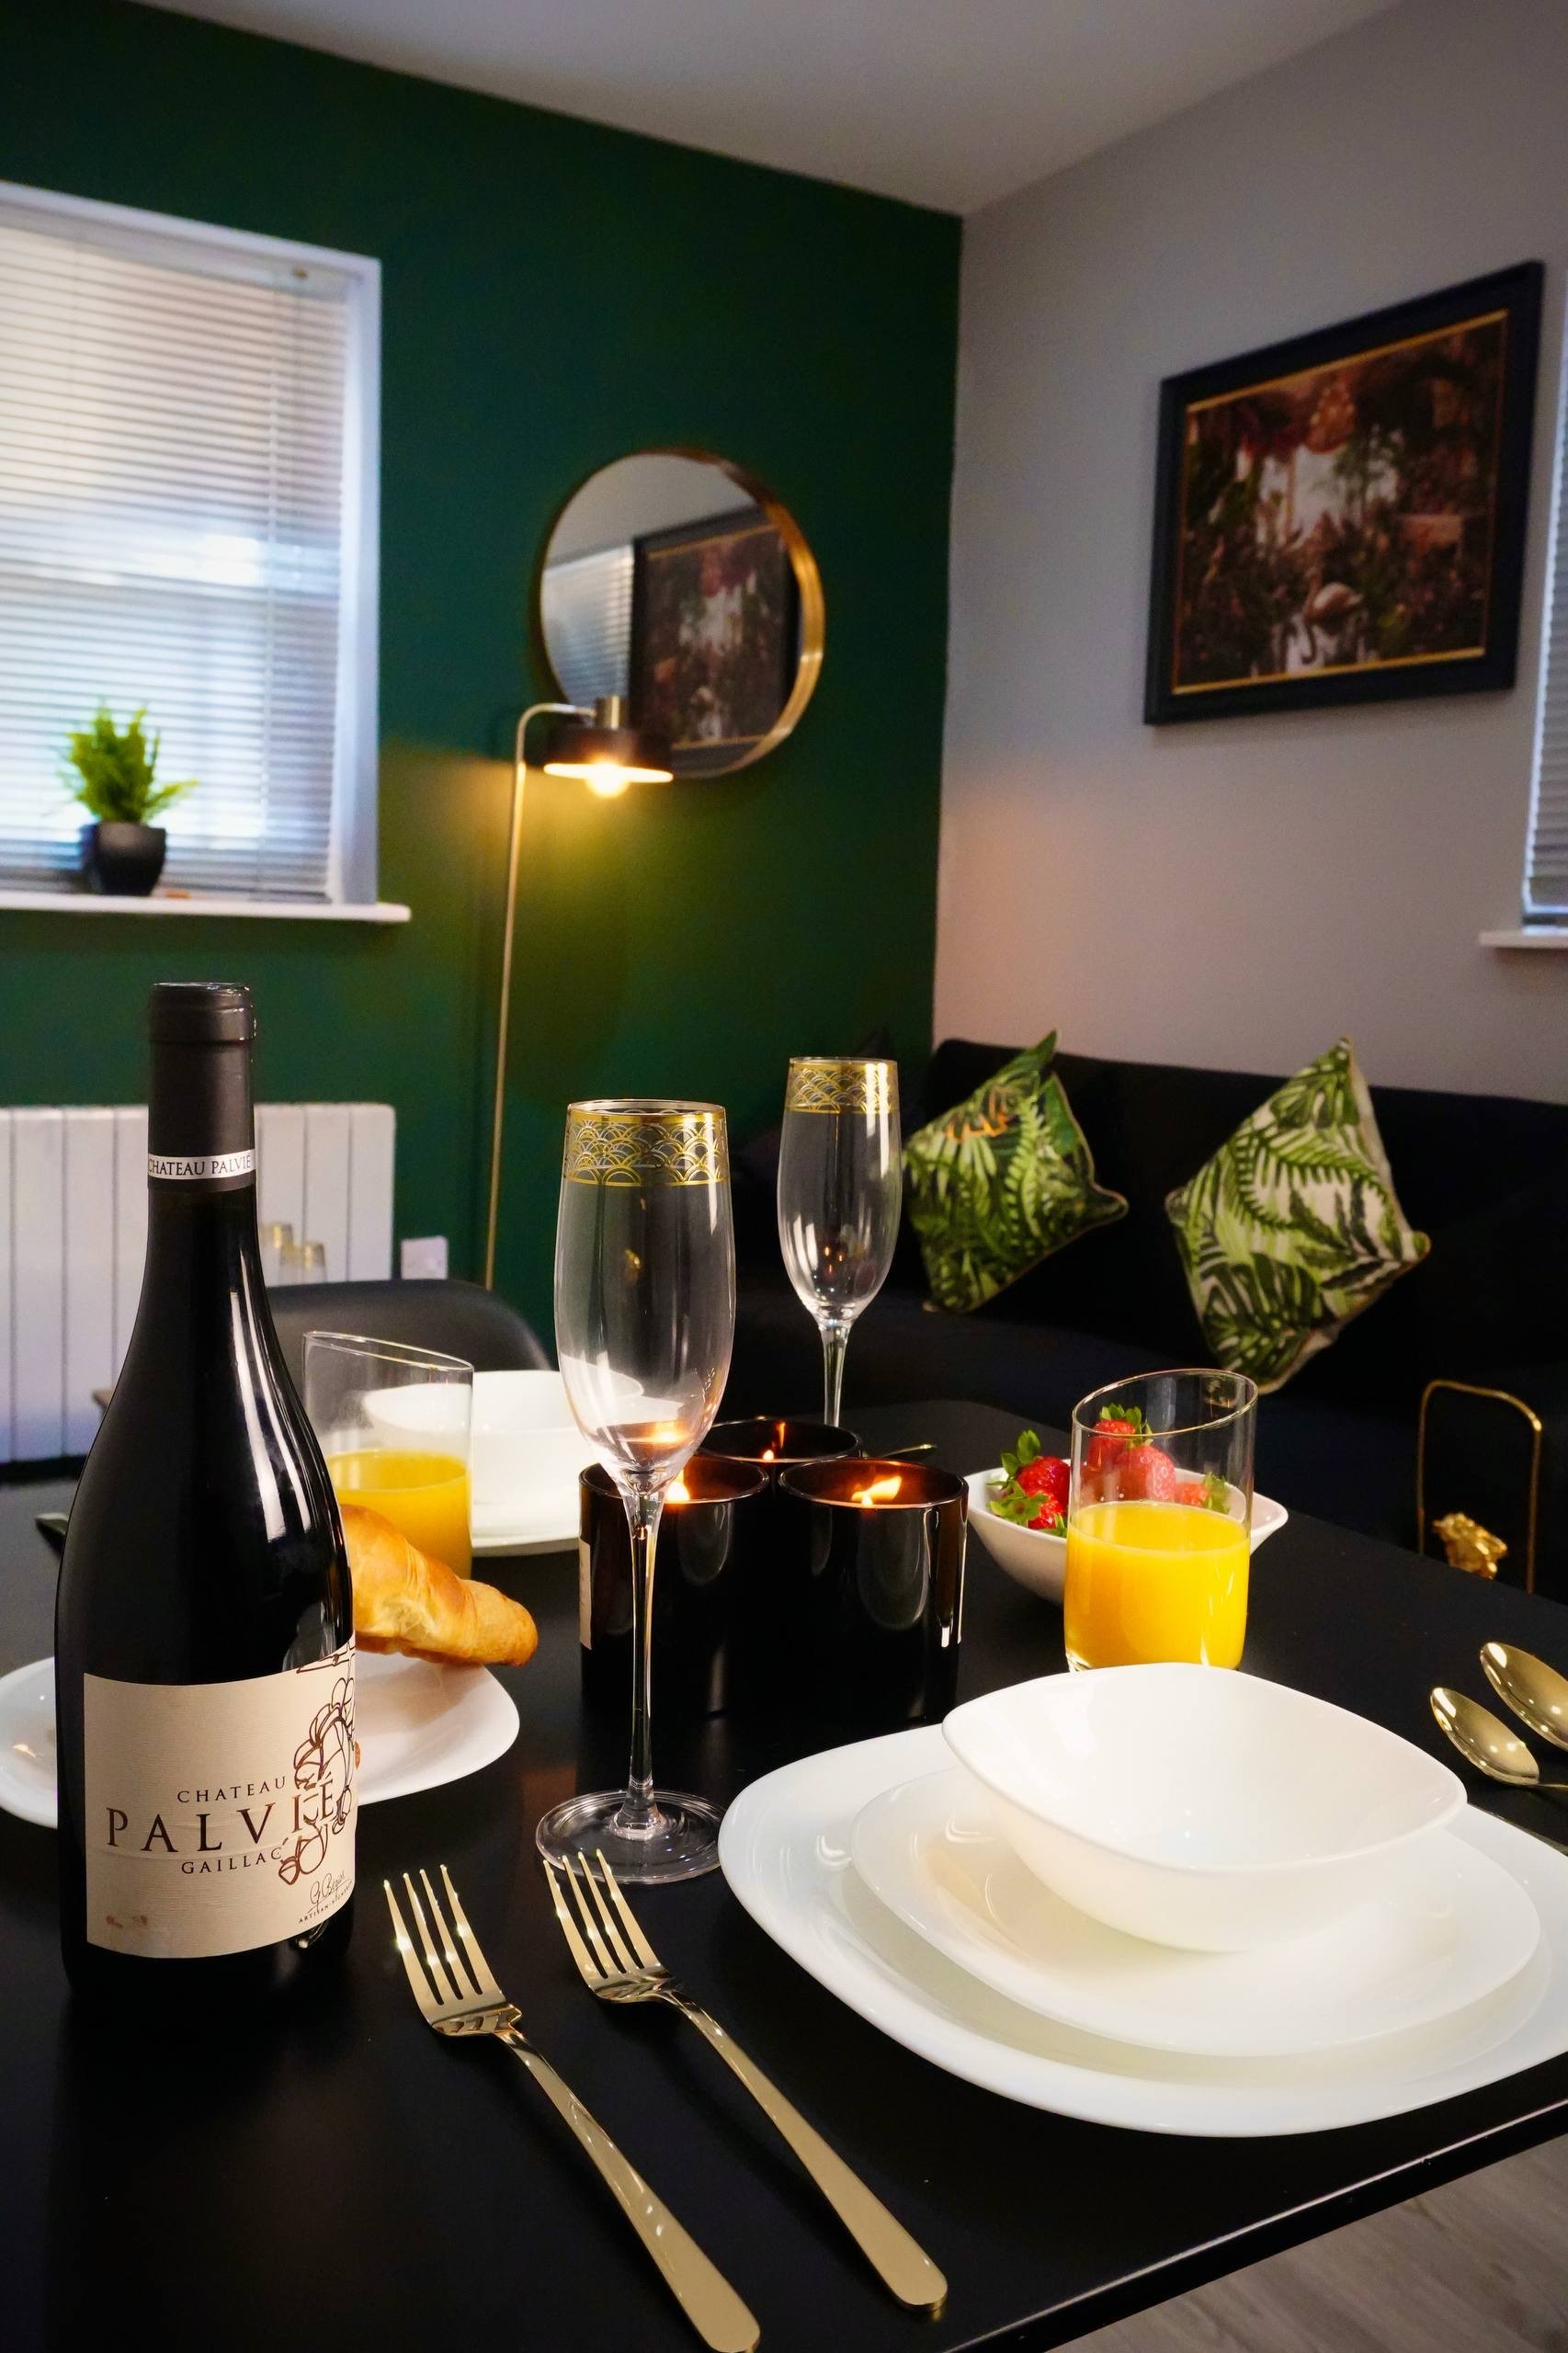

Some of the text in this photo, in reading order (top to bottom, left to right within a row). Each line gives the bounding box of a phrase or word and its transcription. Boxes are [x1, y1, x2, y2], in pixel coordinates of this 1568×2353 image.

[148, 1159, 205, 1176] CHATEAU
[177, 1776, 286, 1803] CHATEAU
[181, 1847, 283, 1874] GAILLAC
